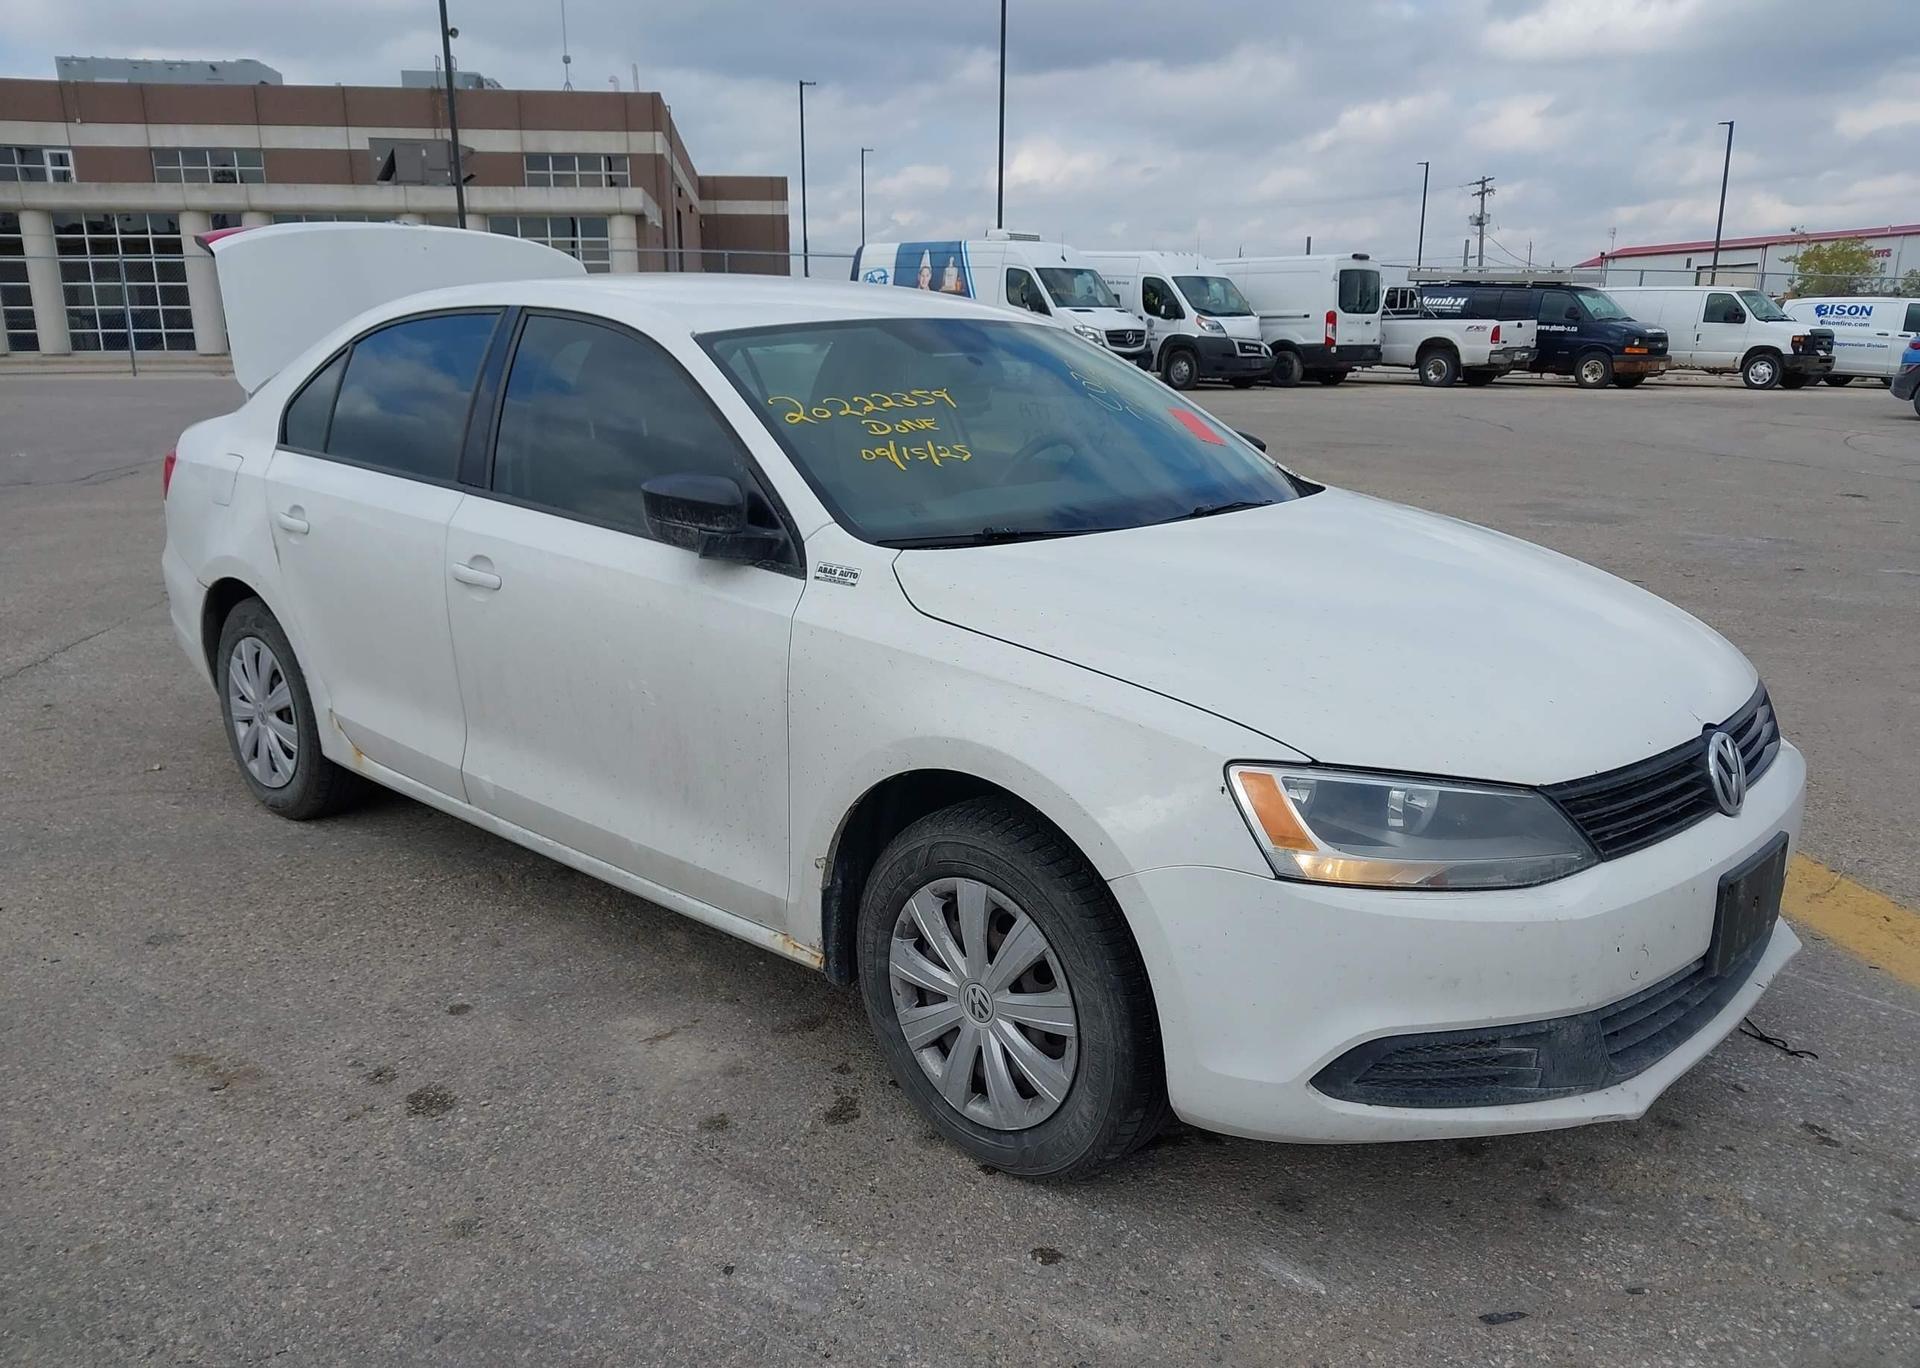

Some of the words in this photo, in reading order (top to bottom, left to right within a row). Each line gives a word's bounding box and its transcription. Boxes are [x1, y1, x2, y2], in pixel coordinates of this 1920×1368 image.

[1815, 304, 1873, 316] BISON
[861, 440, 972, 471] 09/15/25
[817, 566, 838, 576] ABAS
[838, 570, 859, 580] AUTO
